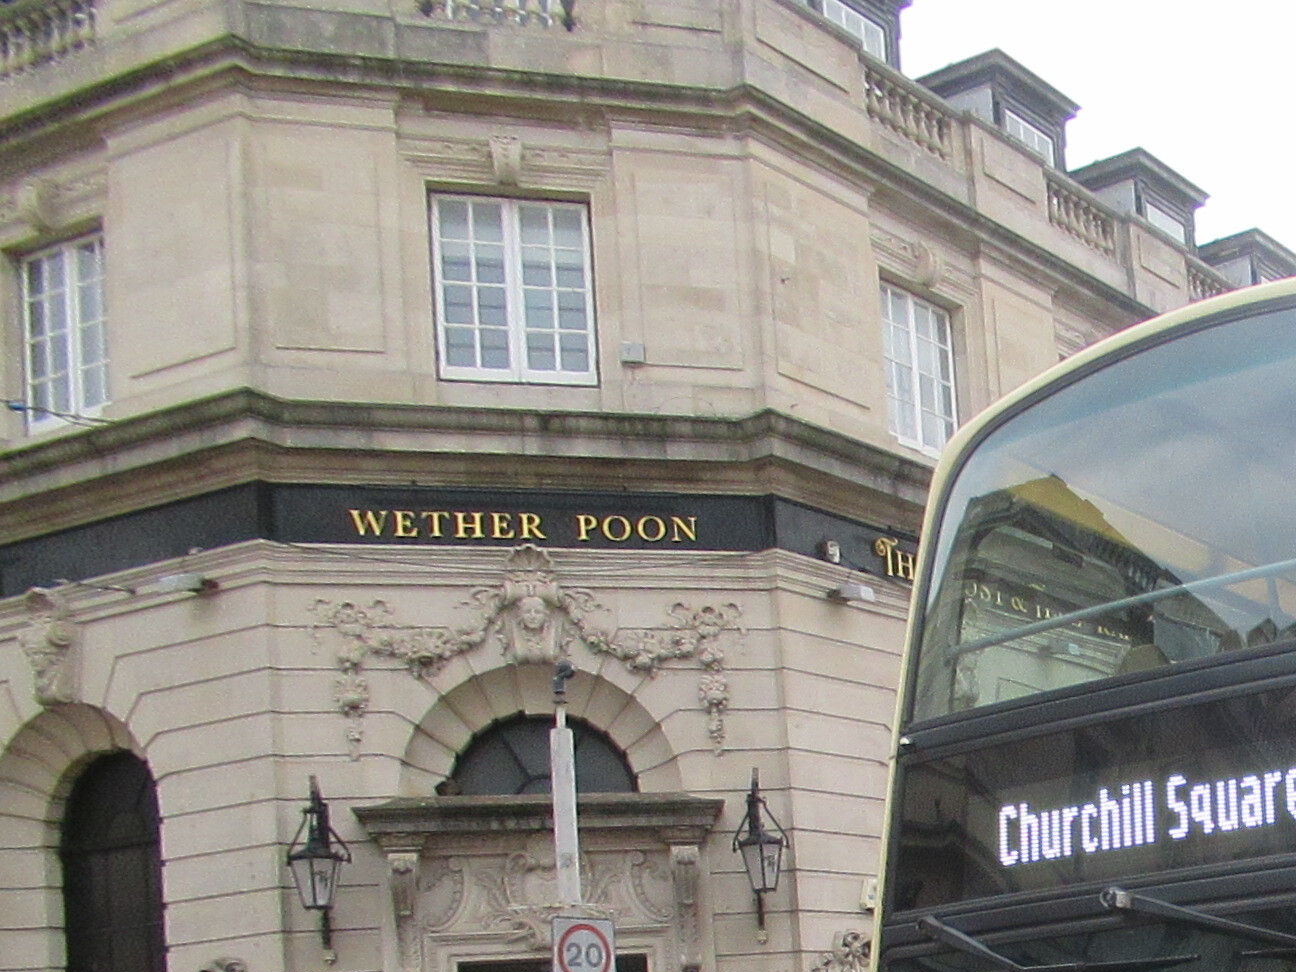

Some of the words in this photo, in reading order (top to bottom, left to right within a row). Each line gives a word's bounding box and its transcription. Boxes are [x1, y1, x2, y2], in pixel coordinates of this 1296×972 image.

[349, 509, 547, 540] WETHER
[576, 514, 698, 543] POON
[875, 536, 916, 579] TH
[999, 779, 1156, 866] Churchill
[566, 943, 603, 968] 20
